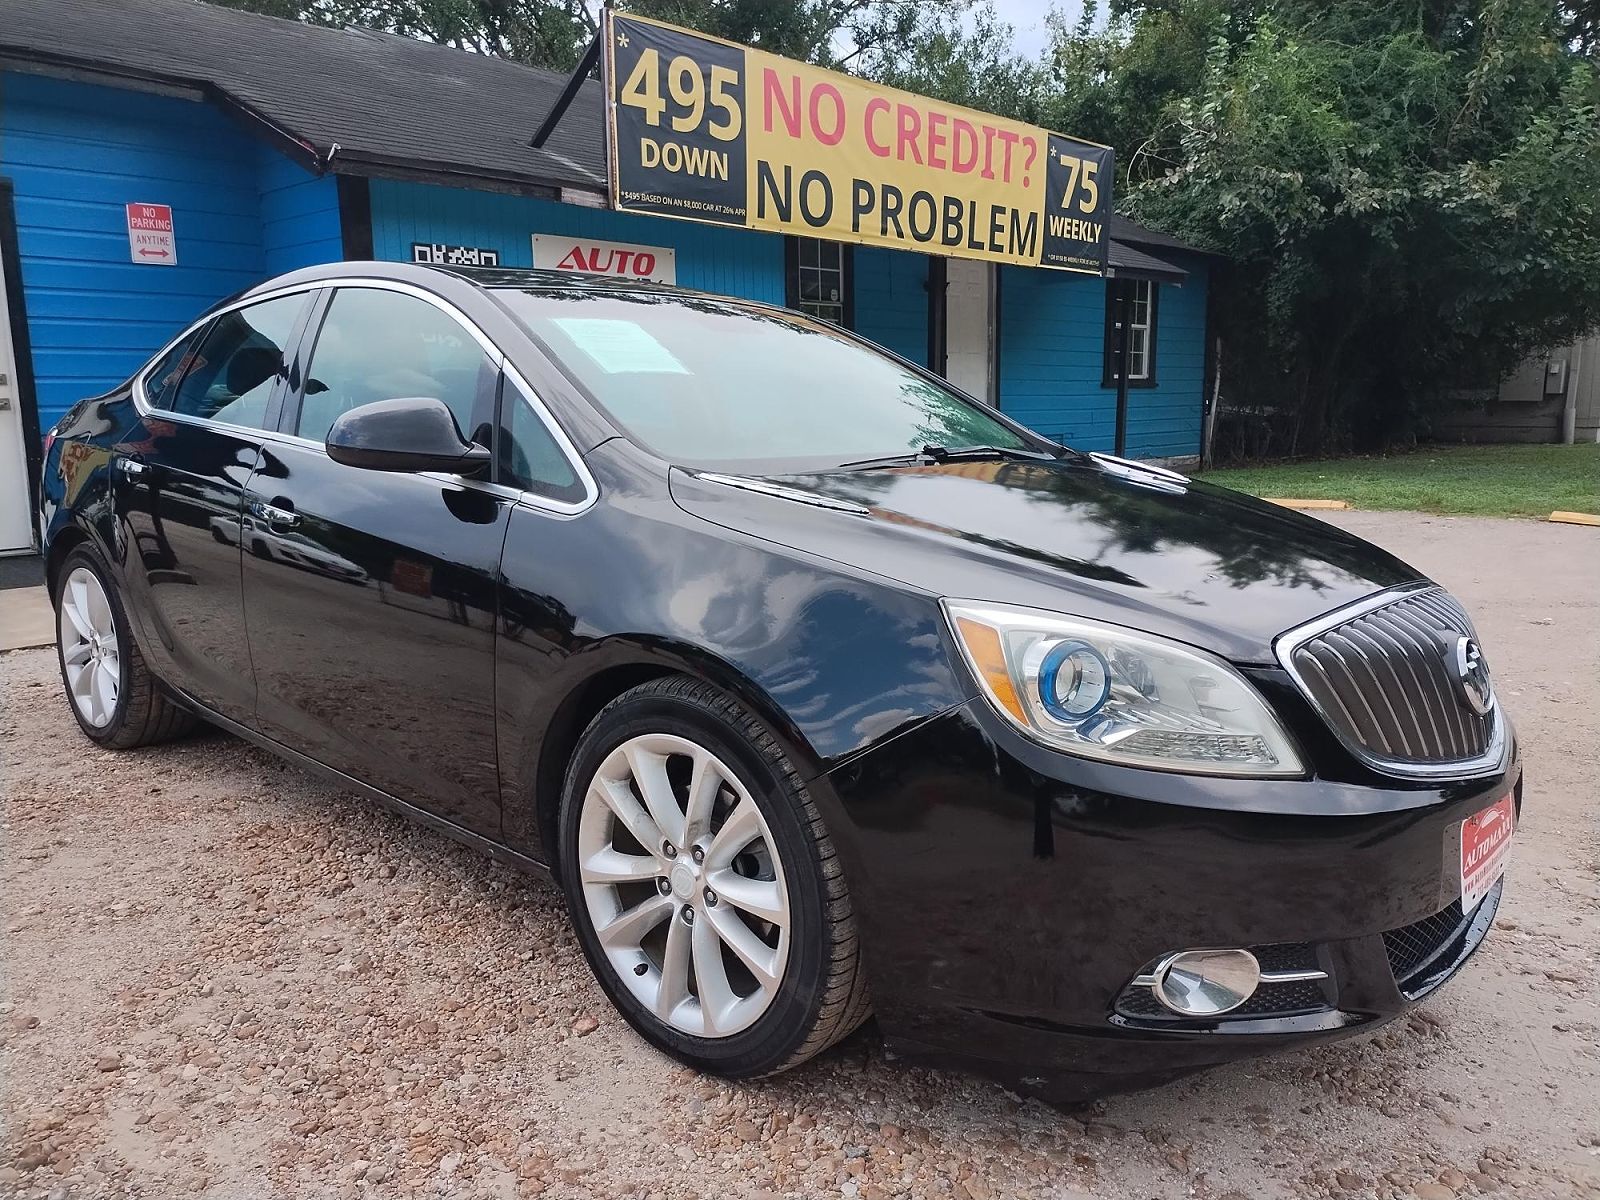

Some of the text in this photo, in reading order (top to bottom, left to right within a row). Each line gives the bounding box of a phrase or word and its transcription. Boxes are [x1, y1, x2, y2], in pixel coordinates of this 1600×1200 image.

[763, 67, 1037, 189] NO CREDIT?
[641, 137, 728, 181] DOWN
[142, 207, 156, 218] NO
[641, 194, 662, 204] BASED
[662, 196, 673, 205] ON
[673, 198, 683, 207] AN
[683, 200, 702, 210] $8,000
[702, 202, 714, 212] CAR
[714, 204, 722, 213] AT
[722, 206, 734, 214] 26%
[734, 207, 746, 217] APR
[757, 159, 1038, 257] NO PROBLEM
[131, 217, 171, 230] PARKING
[1049, 214, 1102, 244] WEEKLY
[136, 234, 170, 246] ANYTIME
[556, 246, 656, 276] AUTO
